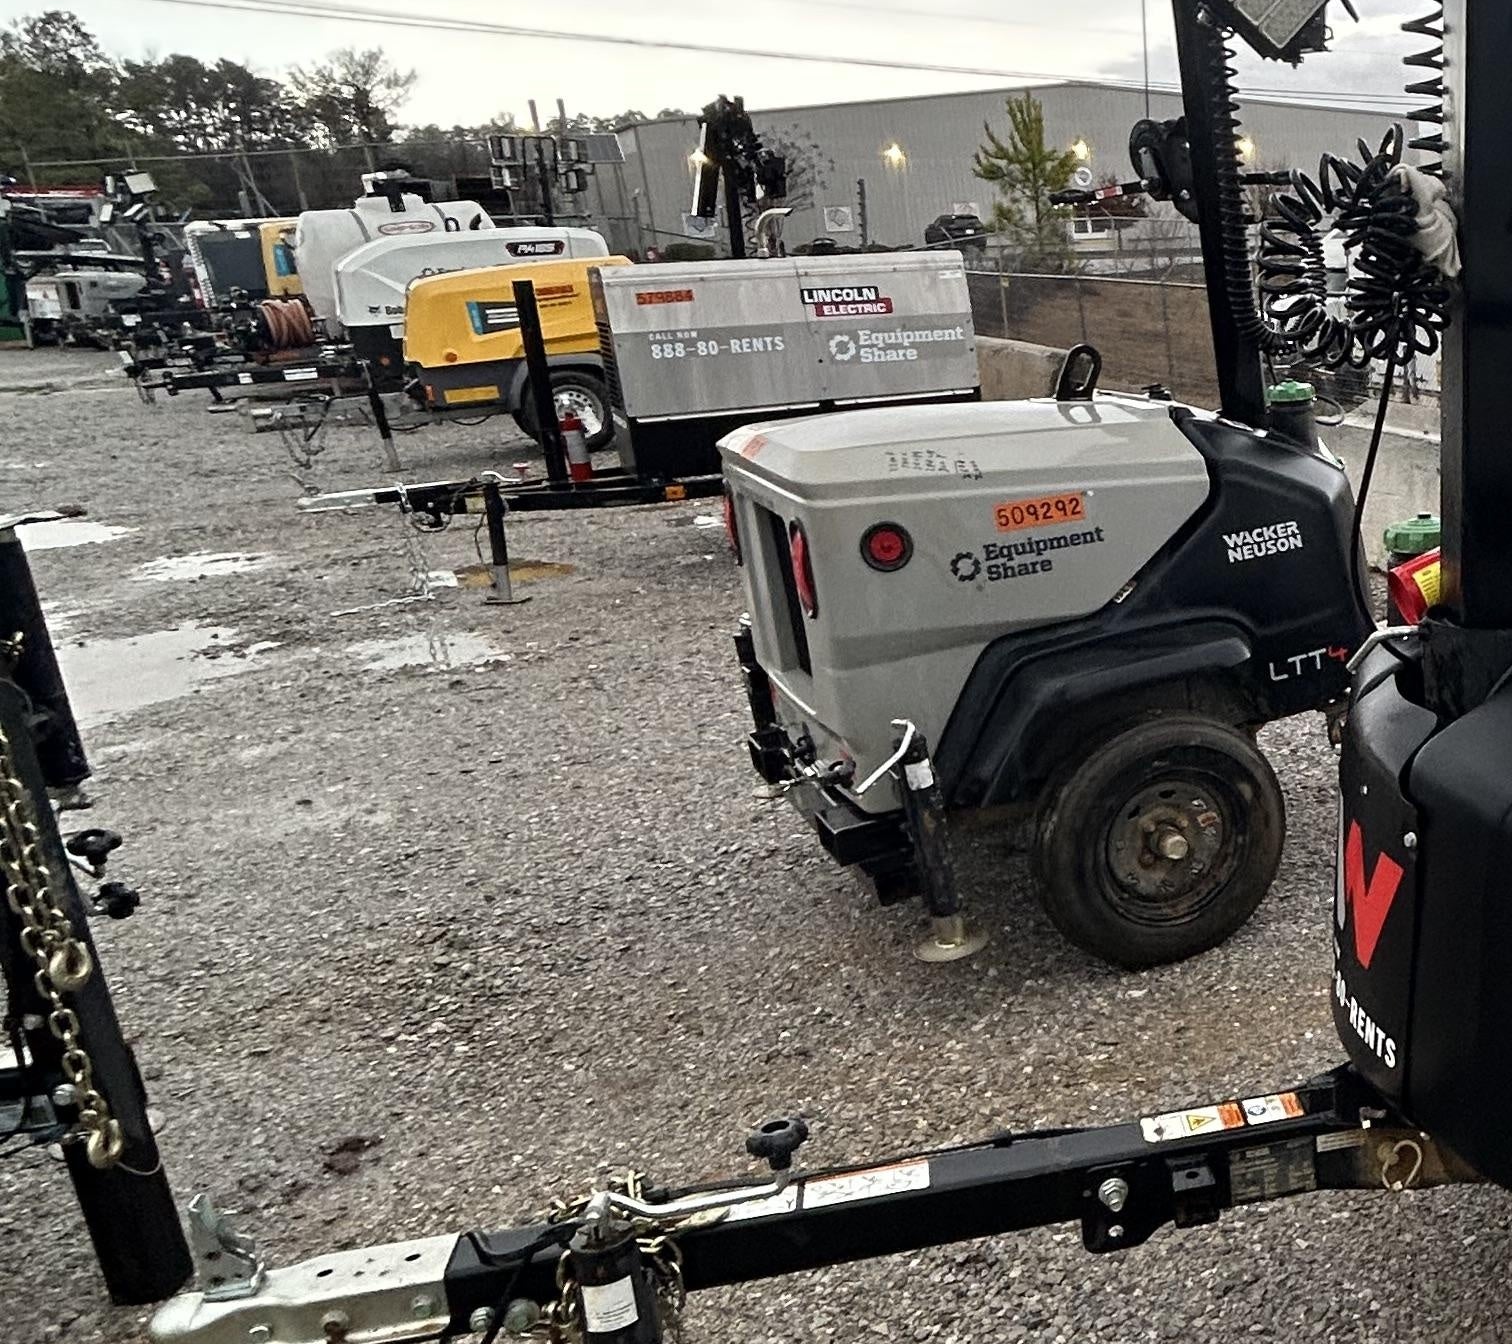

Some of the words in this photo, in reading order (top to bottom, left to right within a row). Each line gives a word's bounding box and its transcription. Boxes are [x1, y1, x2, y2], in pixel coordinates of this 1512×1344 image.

[803, 288, 877, 303] LINCOLN
[822, 302, 887, 316] ELECTRIC
[649, 331, 673, 341] CALL
[676, 330, 698, 339] NOW
[857, 326, 964, 349] Equipment
[651, 336, 785, 359] 888-80-RENTS
[859, 346, 919, 363] Share
[997, 497, 1082, 527] 509292
[983, 526, 1105, 561] Equipment
[1222, 521, 1300, 548] WACKER
[1227, 534, 1304, 564] NEUSON
[986, 558, 1053, 582] Share
